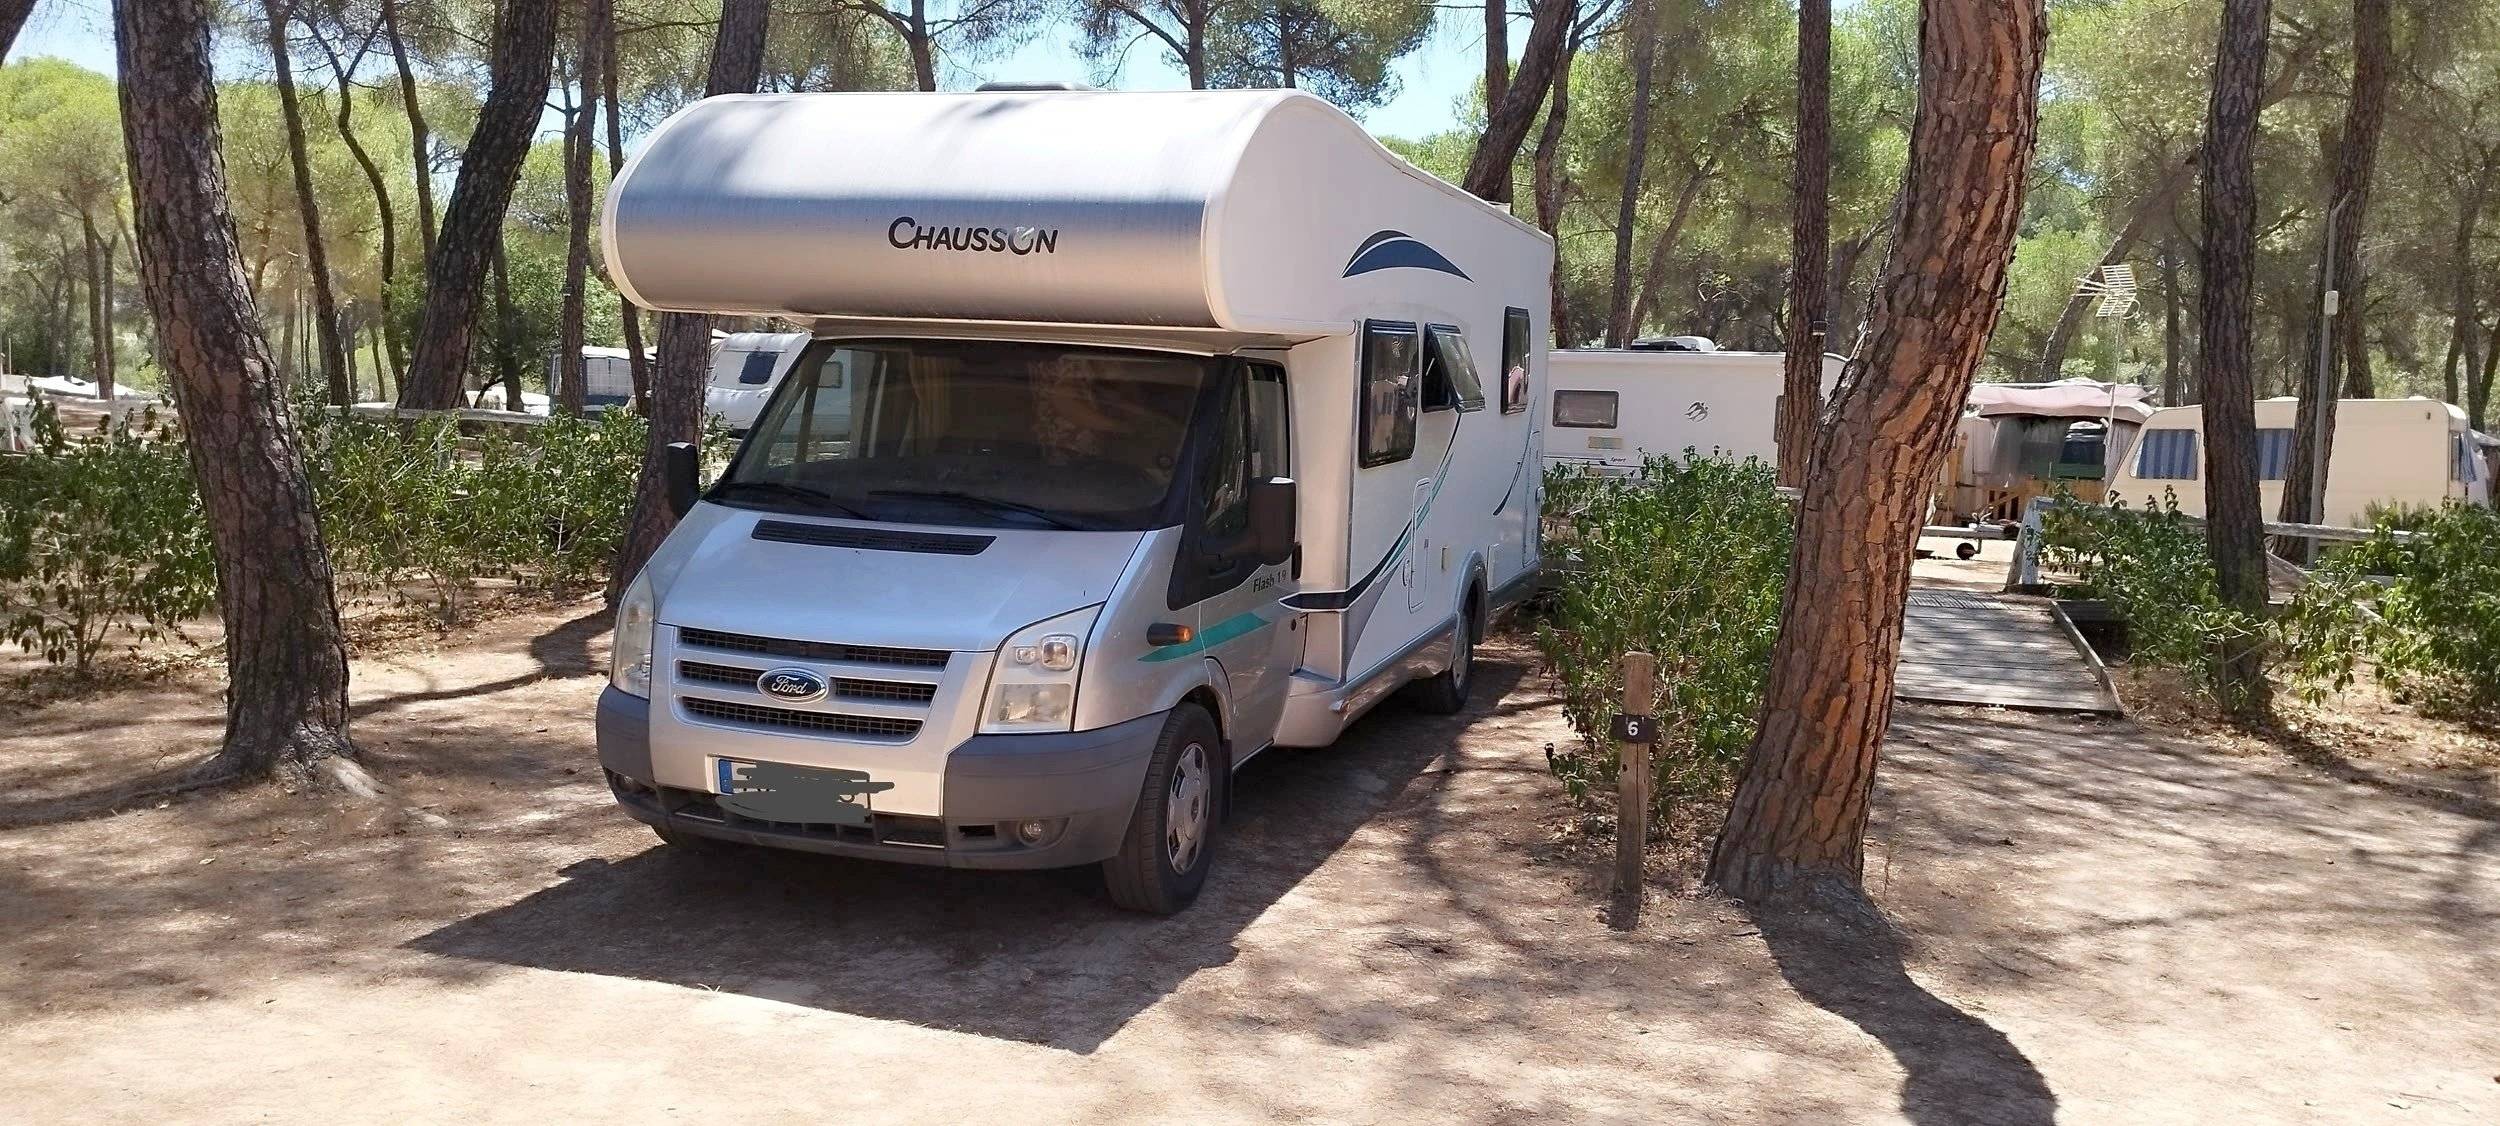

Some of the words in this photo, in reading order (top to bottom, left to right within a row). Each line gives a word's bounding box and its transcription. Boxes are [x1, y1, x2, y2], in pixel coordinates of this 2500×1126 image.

[1253, 573, 1275, 593] Flash
[771, 675, 808, 694] Ford
[1628, 721, 1639, 736] 6
